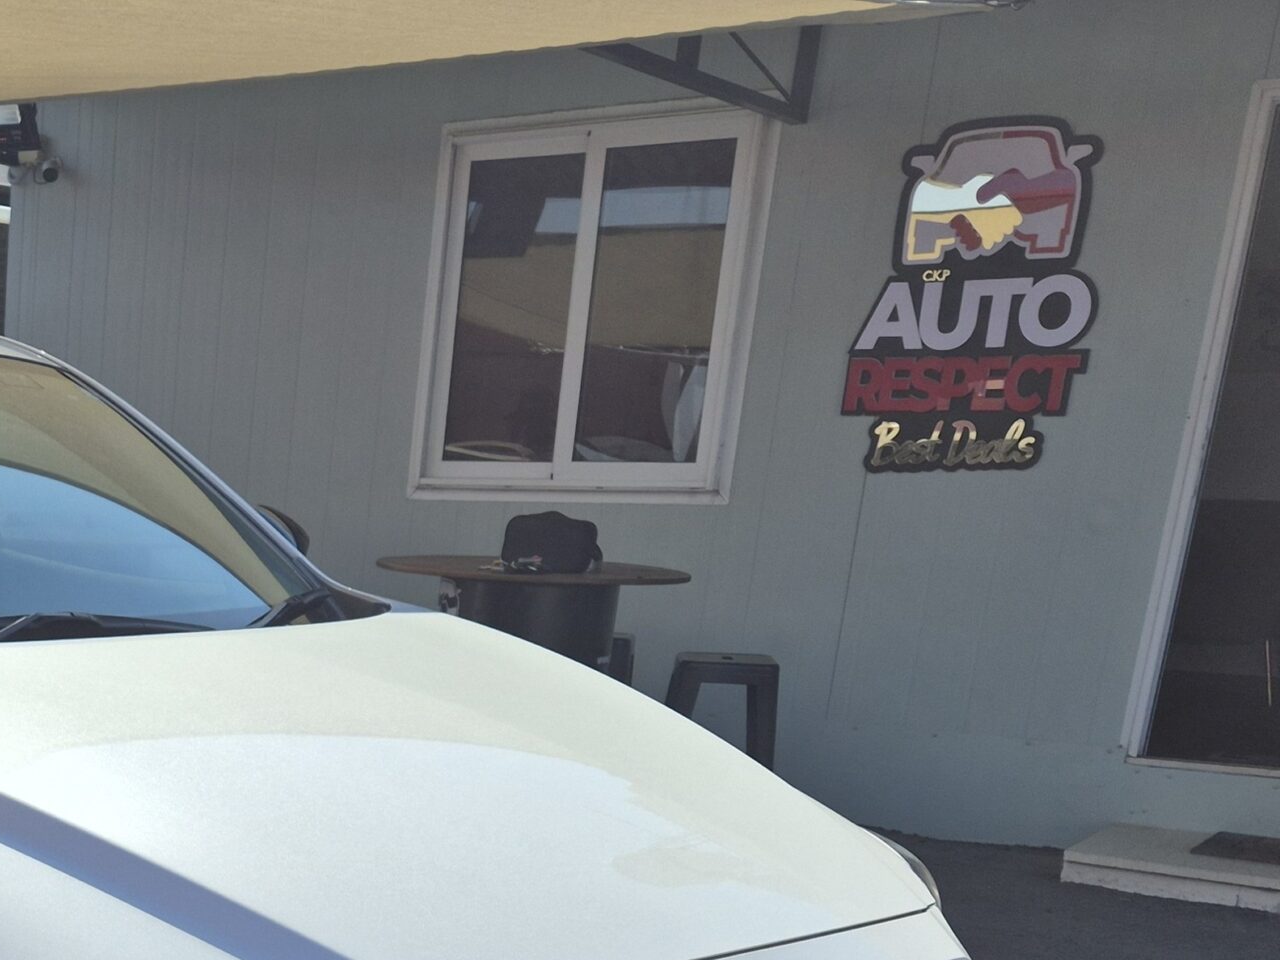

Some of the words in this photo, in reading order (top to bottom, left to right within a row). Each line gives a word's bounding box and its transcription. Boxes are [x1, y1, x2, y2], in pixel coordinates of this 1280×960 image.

[922, 269, 951, 282] CKP
[854, 274, 1092, 351] AUTO
[843, 355, 1081, 412] RESPECT
[871, 420, 943, 466] Best
[943, 418, 1037, 466] Deals
